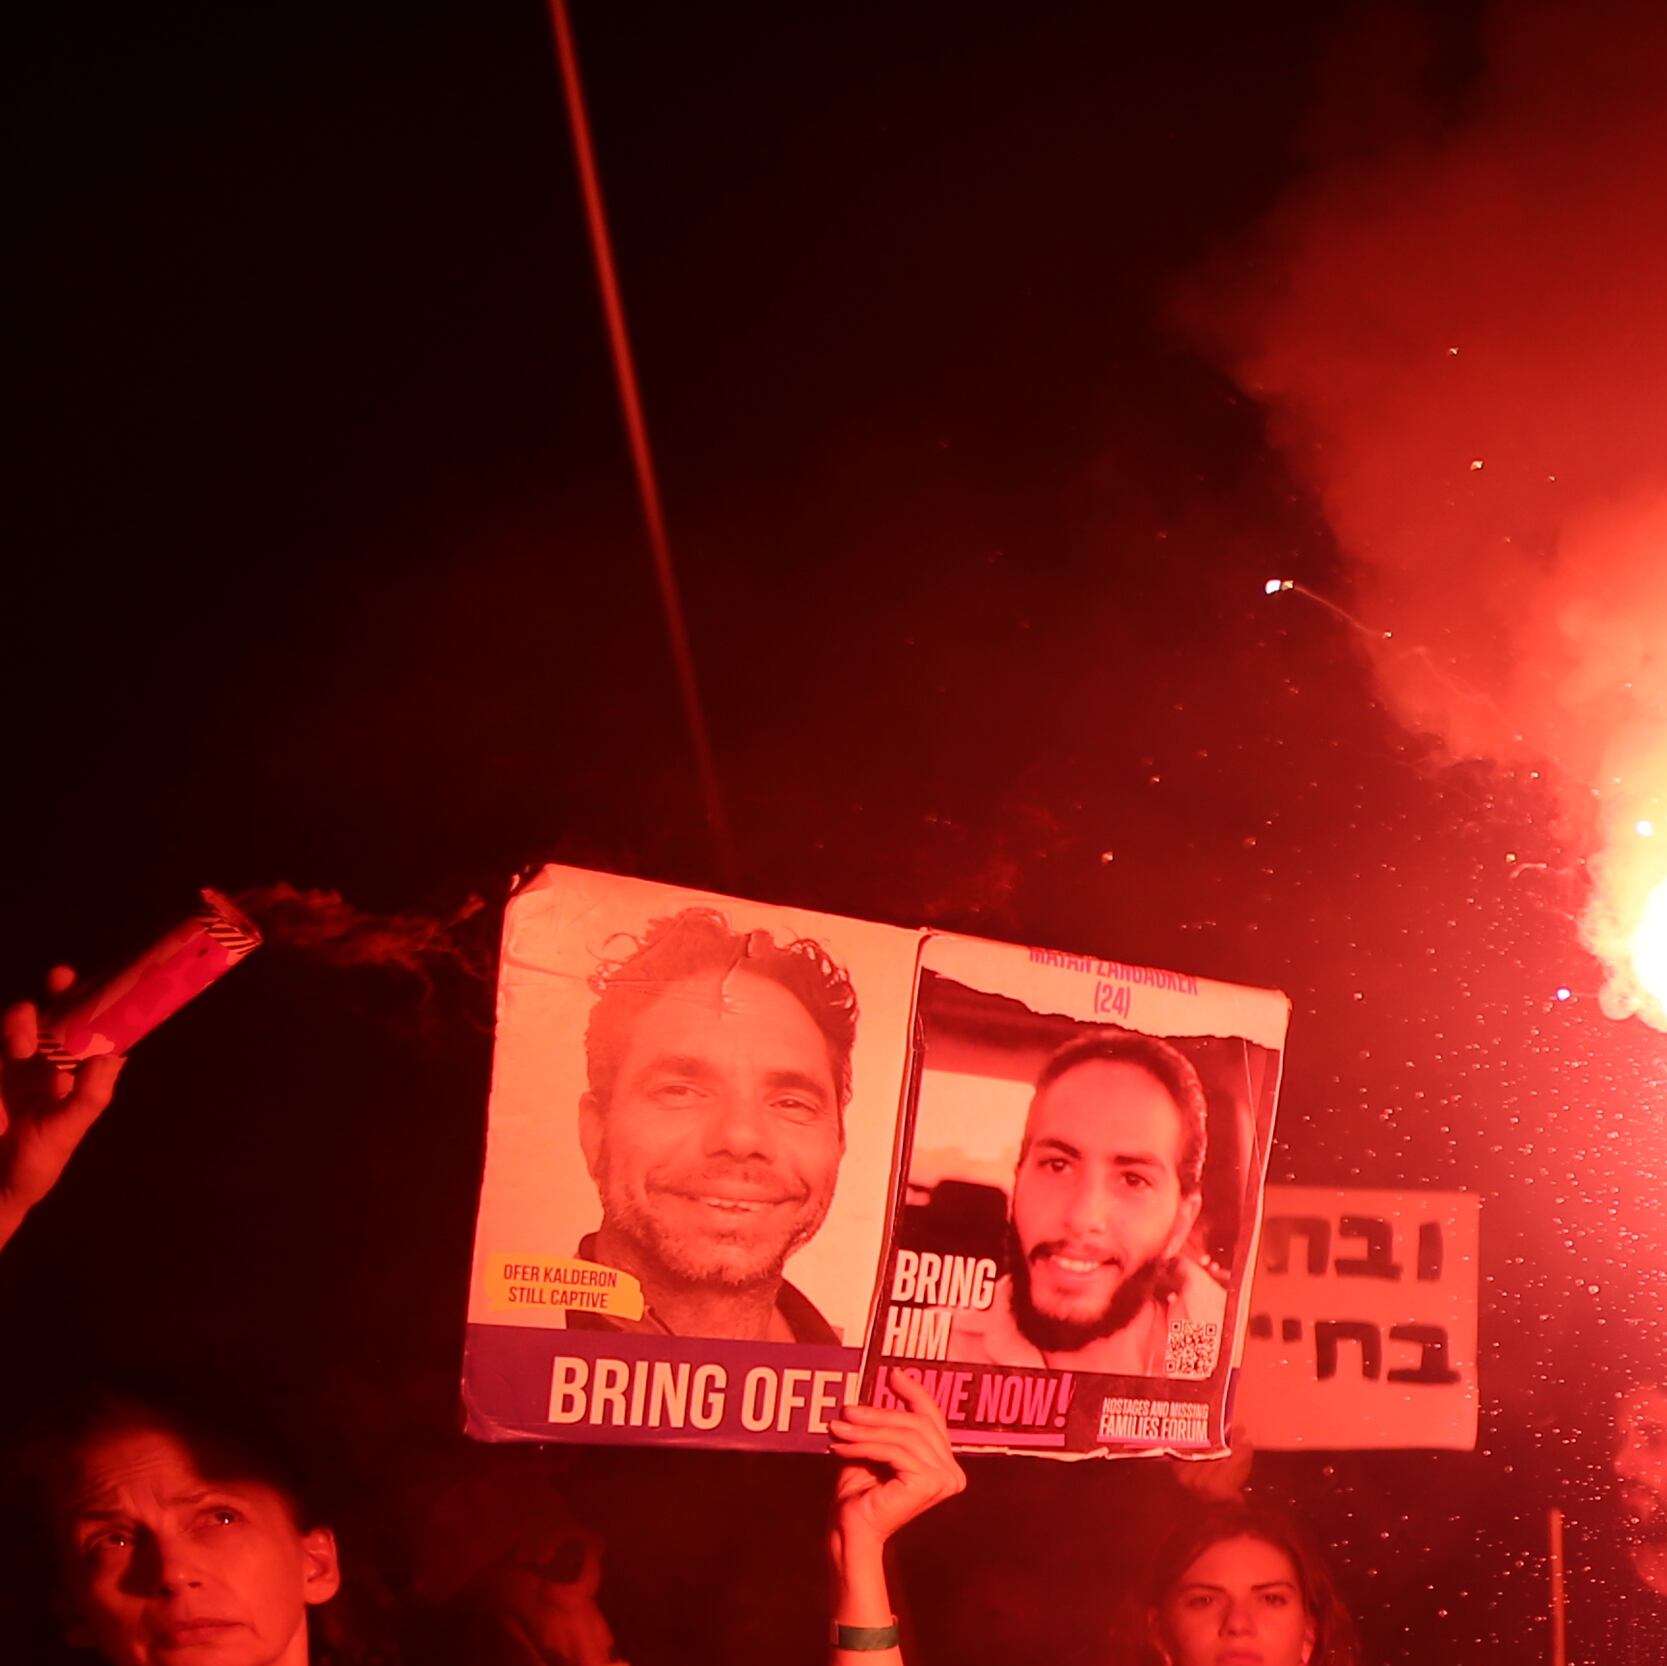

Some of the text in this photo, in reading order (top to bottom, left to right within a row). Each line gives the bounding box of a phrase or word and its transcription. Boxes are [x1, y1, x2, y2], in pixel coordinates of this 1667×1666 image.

[1094, 981, 1130, 1019] (24)
[503, 1264, 617, 1288] OFER KALDERON
[890, 1249, 997, 1310] BRING
[508, 1287, 608, 1308] STILL CAPTIVE
[881, 1306, 952, 1360] HIM
[547, 1355, 727, 1431] BRING
[975, 1373, 1074, 1429] NOW!
[1102, 1397, 1209, 1420] HOSTAGES AND MISSING
[1099, 1415, 1208, 1442] FAMILIES FORUM
